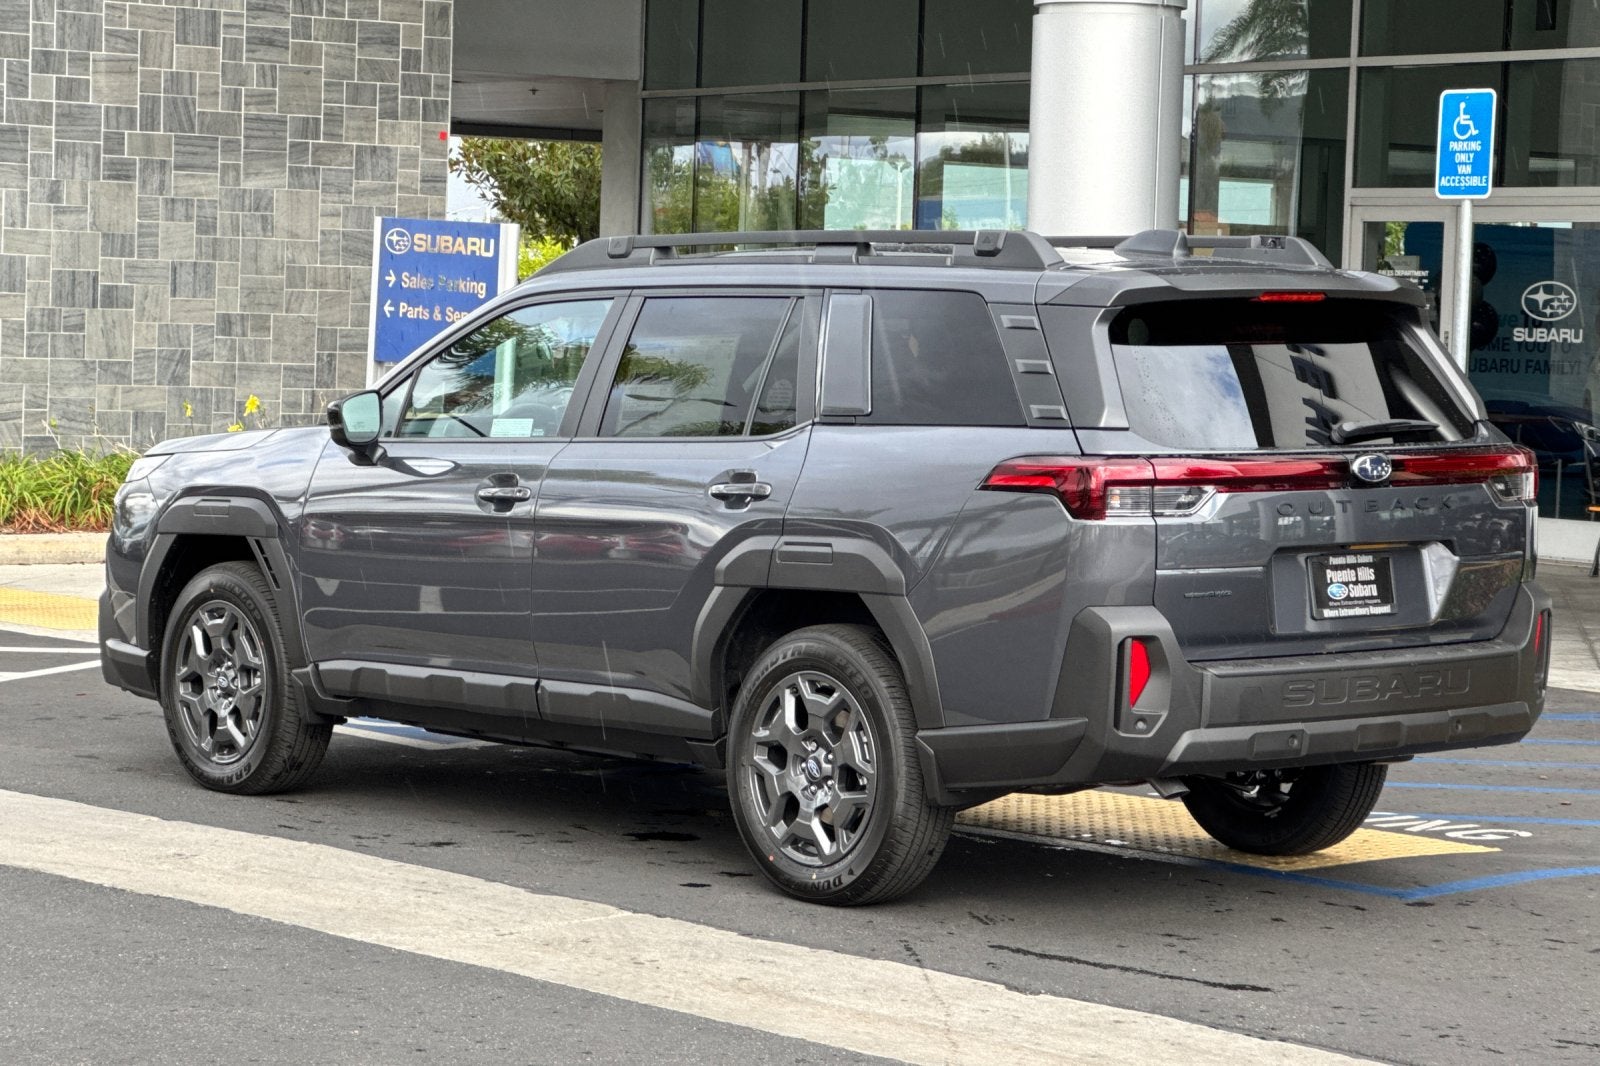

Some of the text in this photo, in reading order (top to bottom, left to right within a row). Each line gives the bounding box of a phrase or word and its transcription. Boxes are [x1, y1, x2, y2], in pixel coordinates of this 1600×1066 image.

[1449, 141, 1482, 151] PARKING
[1455, 152, 1474, 163] ONLY
[1457, 164, 1472, 174] VAN
[1440, 176, 1487, 187] ACCESSIBLE
[413, 233, 495, 257] SUBARU
[401, 271, 487, 299] Sales Parking
[399, 302, 472, 322] Parts & Ser
[1513, 327, 1583, 343] SUBARU
[1277, 497, 1453, 517] OUTBACK
[1326, 566, 1375, 583] Puente Hills
[1349, 583, 1378, 597] Subaru
[1283, 668, 1471, 707] SUBARU
